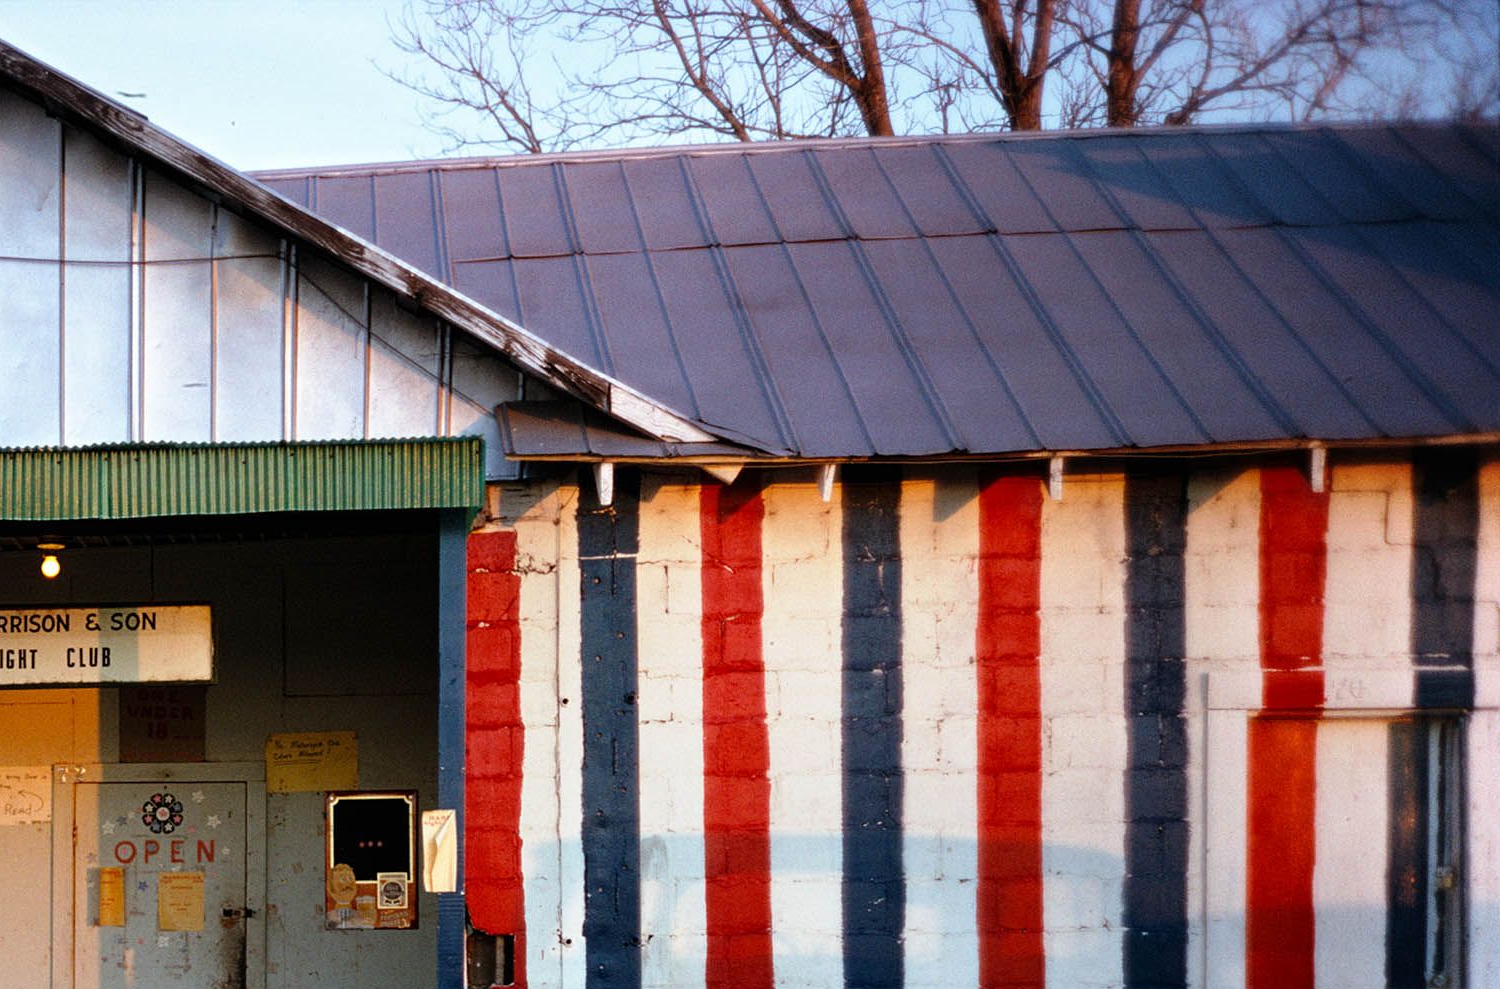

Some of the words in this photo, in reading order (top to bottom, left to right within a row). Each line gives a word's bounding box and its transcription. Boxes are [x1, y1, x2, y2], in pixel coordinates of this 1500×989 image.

[85, 613, 101, 632] &
[110, 612, 157, 631] SON
[66, 647, 112, 668] CLUB
[115, 839, 215, 864] OPEN
